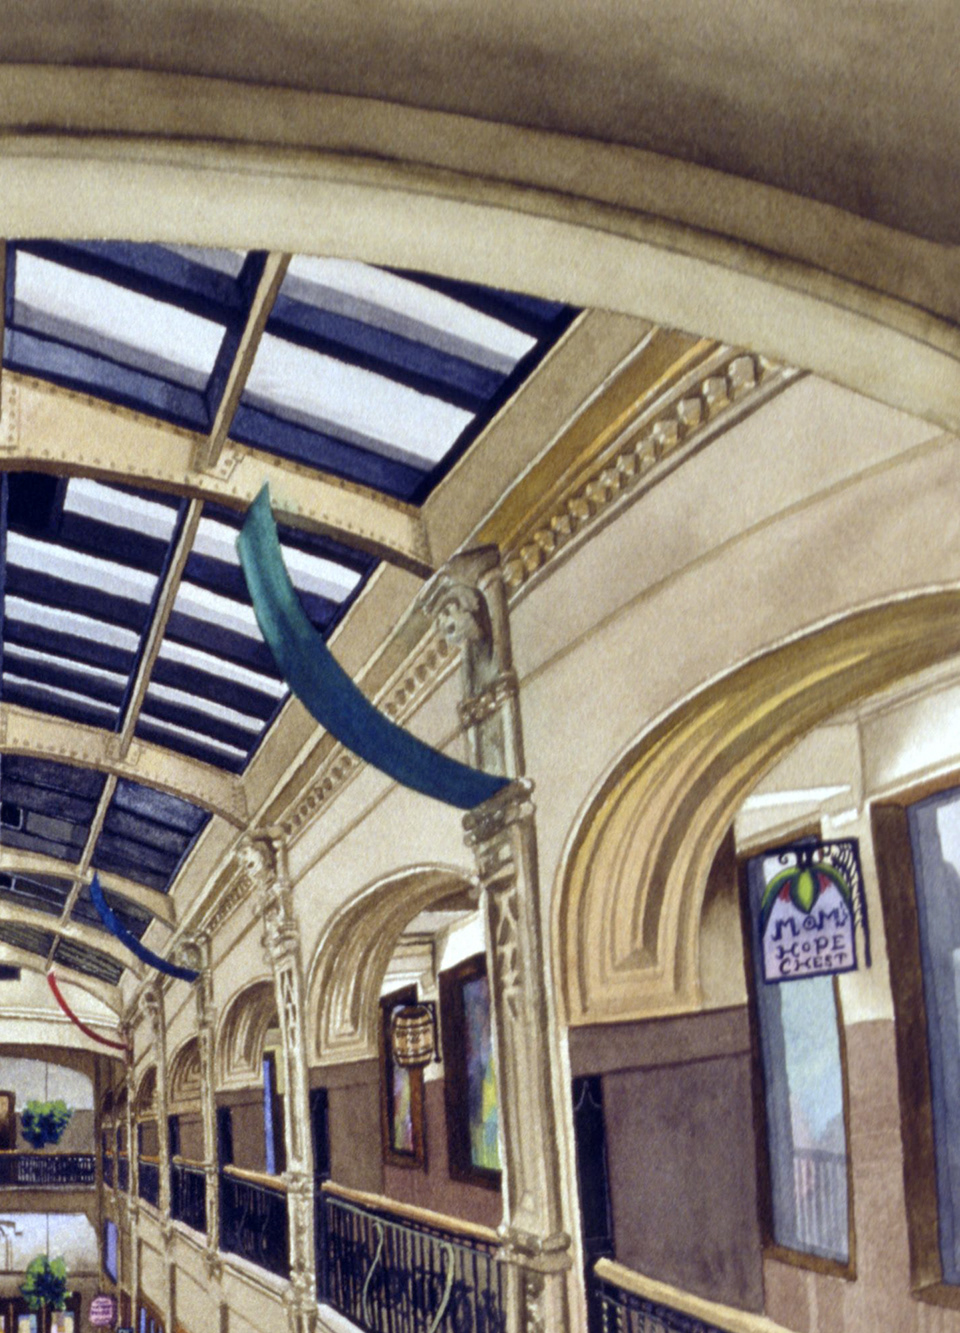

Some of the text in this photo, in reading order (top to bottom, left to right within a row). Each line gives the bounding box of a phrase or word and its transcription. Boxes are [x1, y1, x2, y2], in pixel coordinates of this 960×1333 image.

[771, 901, 848, 941] MOM'S
[775, 934, 845, 960] HOPE
[779, 952, 847, 975] CHEST
